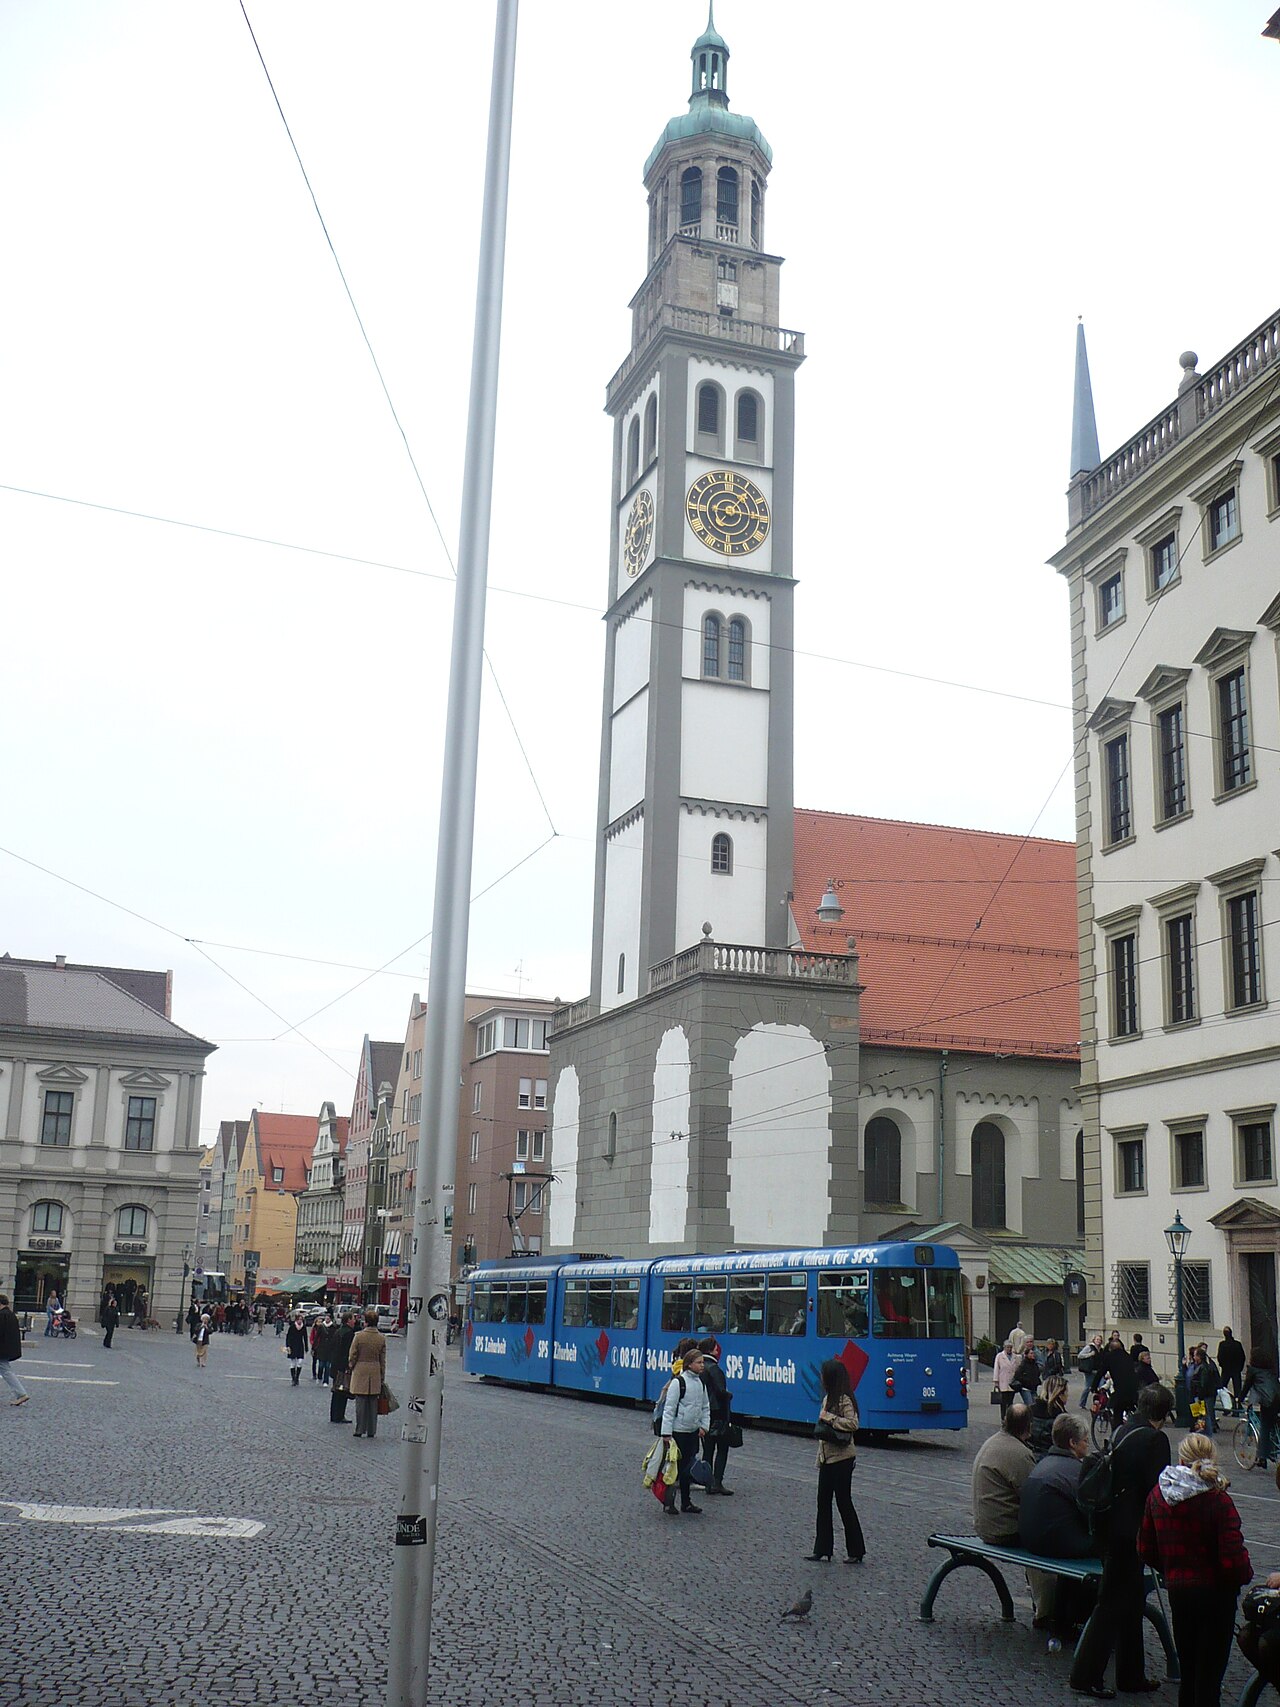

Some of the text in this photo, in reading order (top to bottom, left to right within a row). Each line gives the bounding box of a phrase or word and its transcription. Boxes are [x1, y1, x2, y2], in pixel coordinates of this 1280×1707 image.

[28, 1238, 63, 1248] EGER
[114, 1242, 148, 1252] EGER
[803, 1251, 832, 1267] fahren
[833, 1249, 851, 1265] für
[852, 1248, 880, 1264] SPS.
[537, 1339, 549, 1359] SPS
[725, 1355, 796, 1385] SPS Zeitarbeit
[922, 1387, 936, 1398] 805
